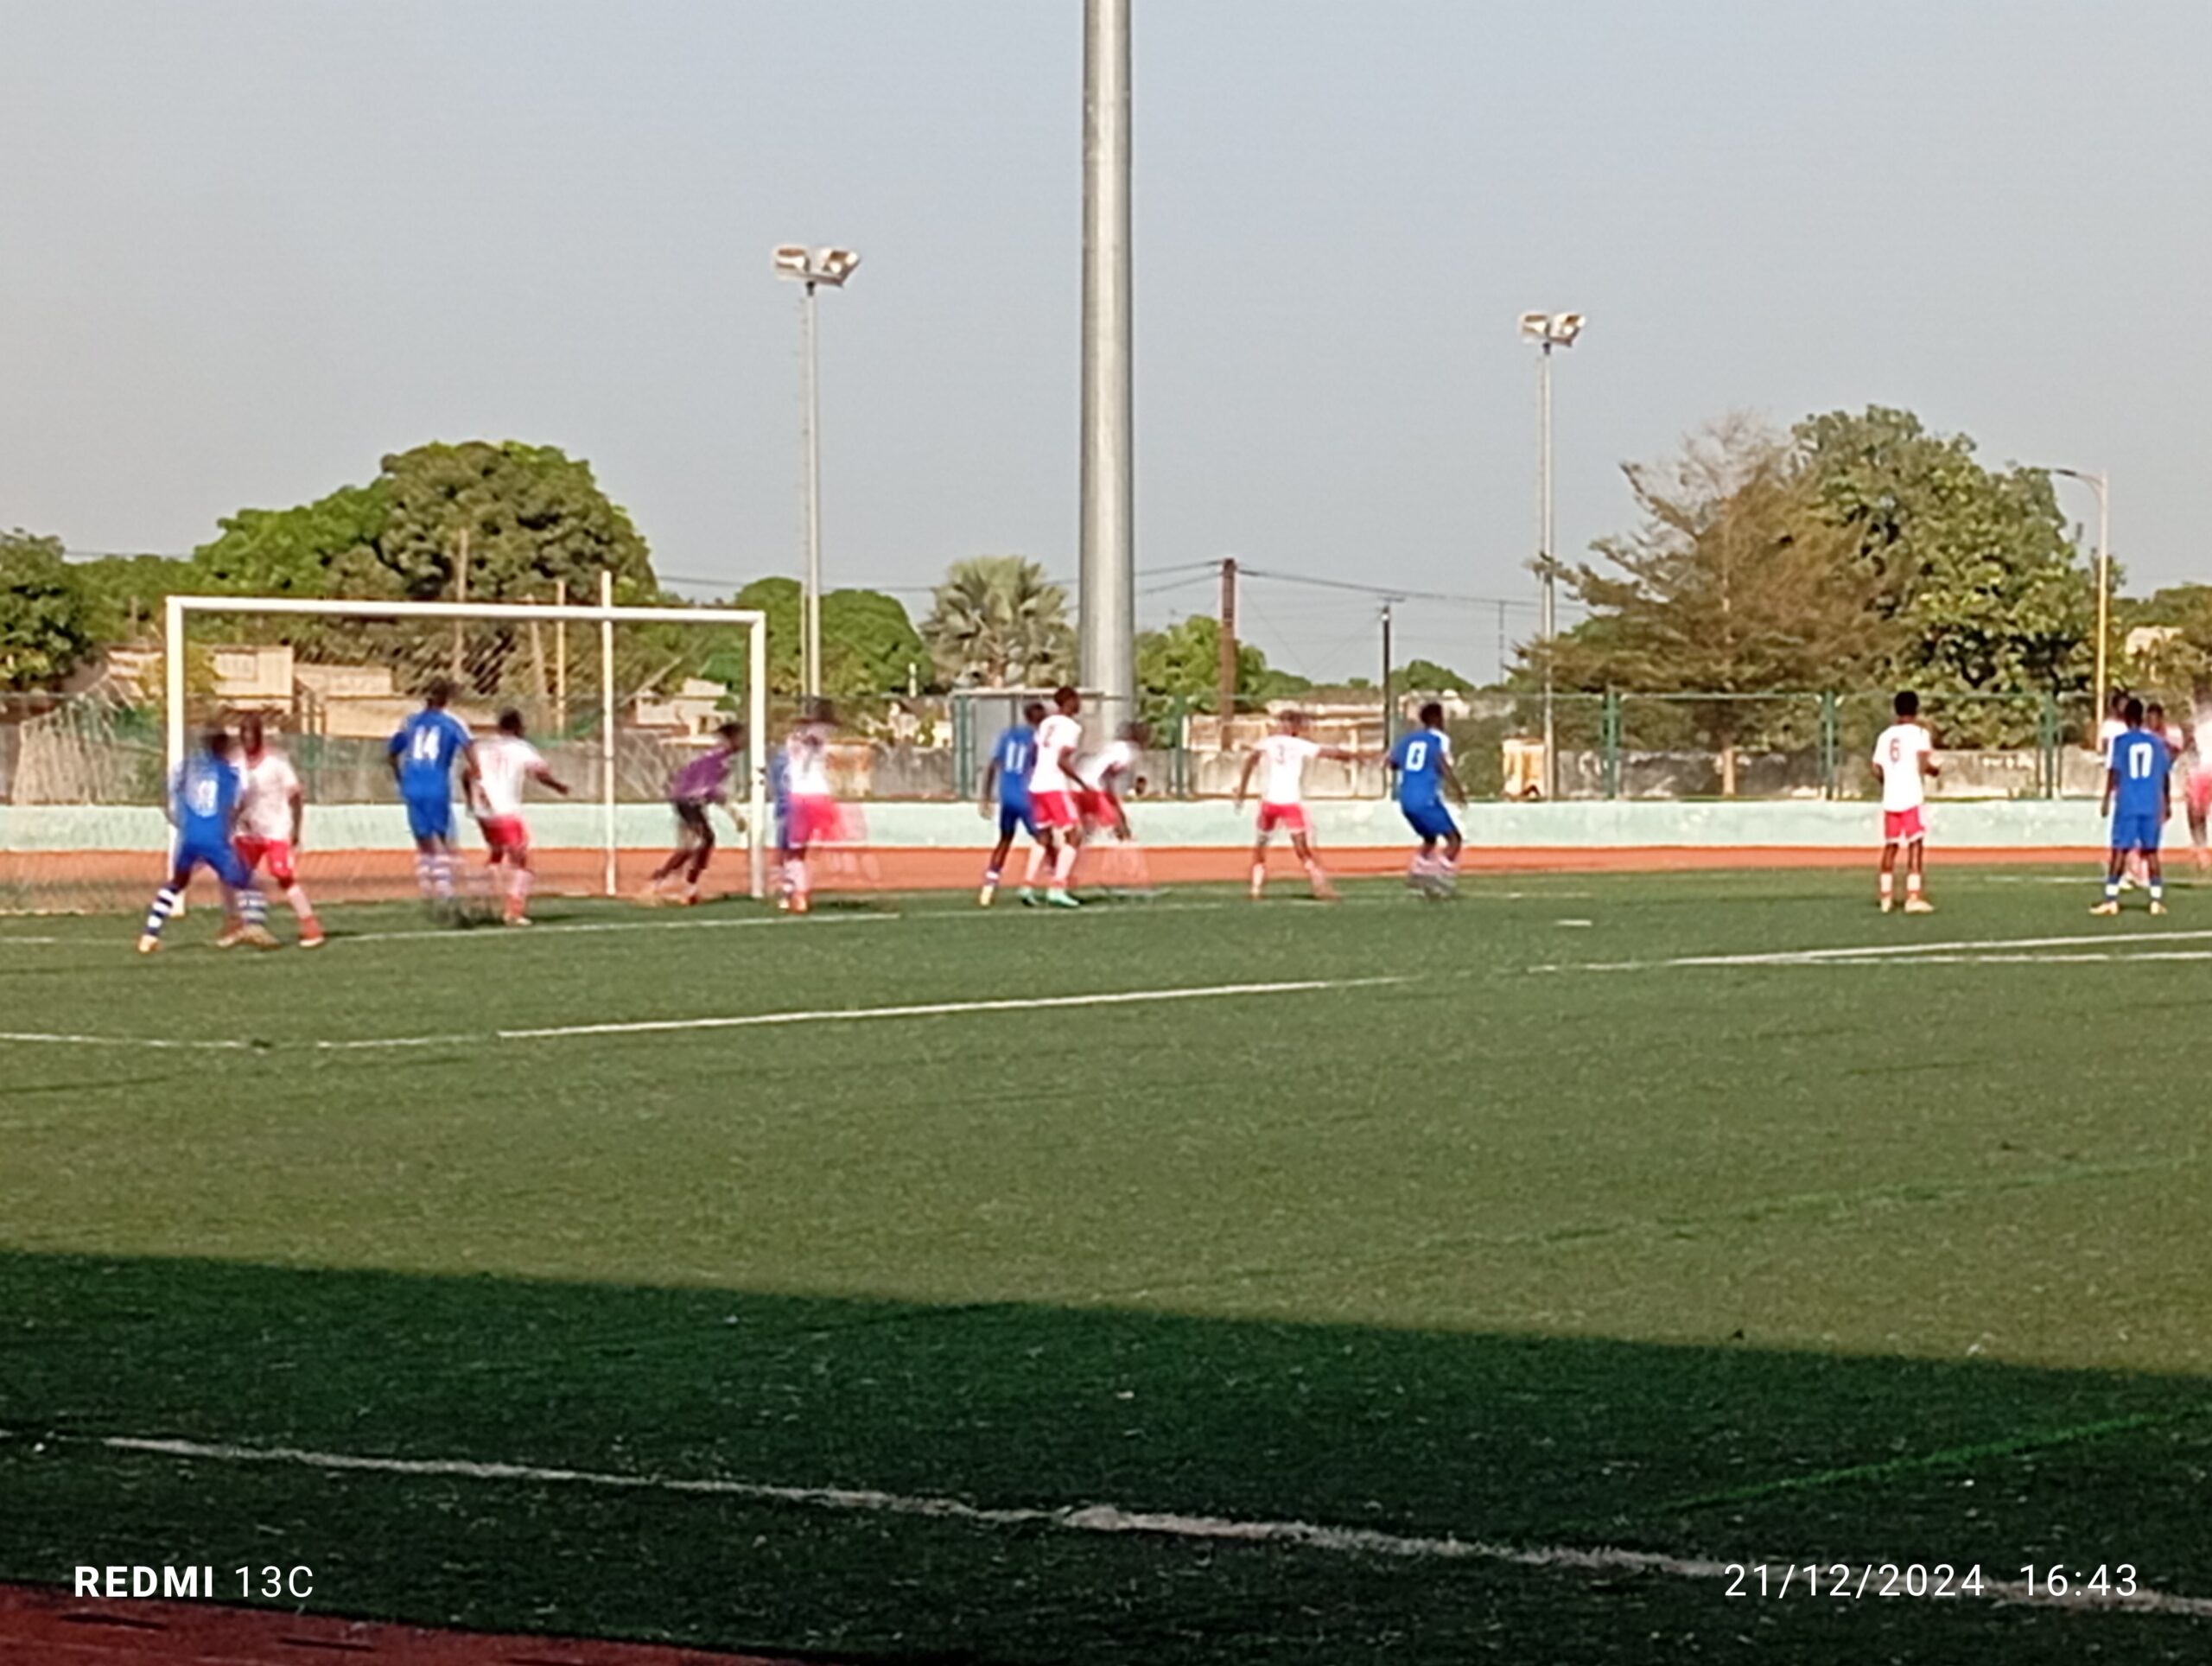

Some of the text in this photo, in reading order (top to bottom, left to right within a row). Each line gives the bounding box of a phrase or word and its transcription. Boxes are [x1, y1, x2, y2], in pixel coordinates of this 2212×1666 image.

[413, 724, 440, 761] 14
[1005, 740, 1026, 774] 11
[1890, 737, 1900, 763] 6
